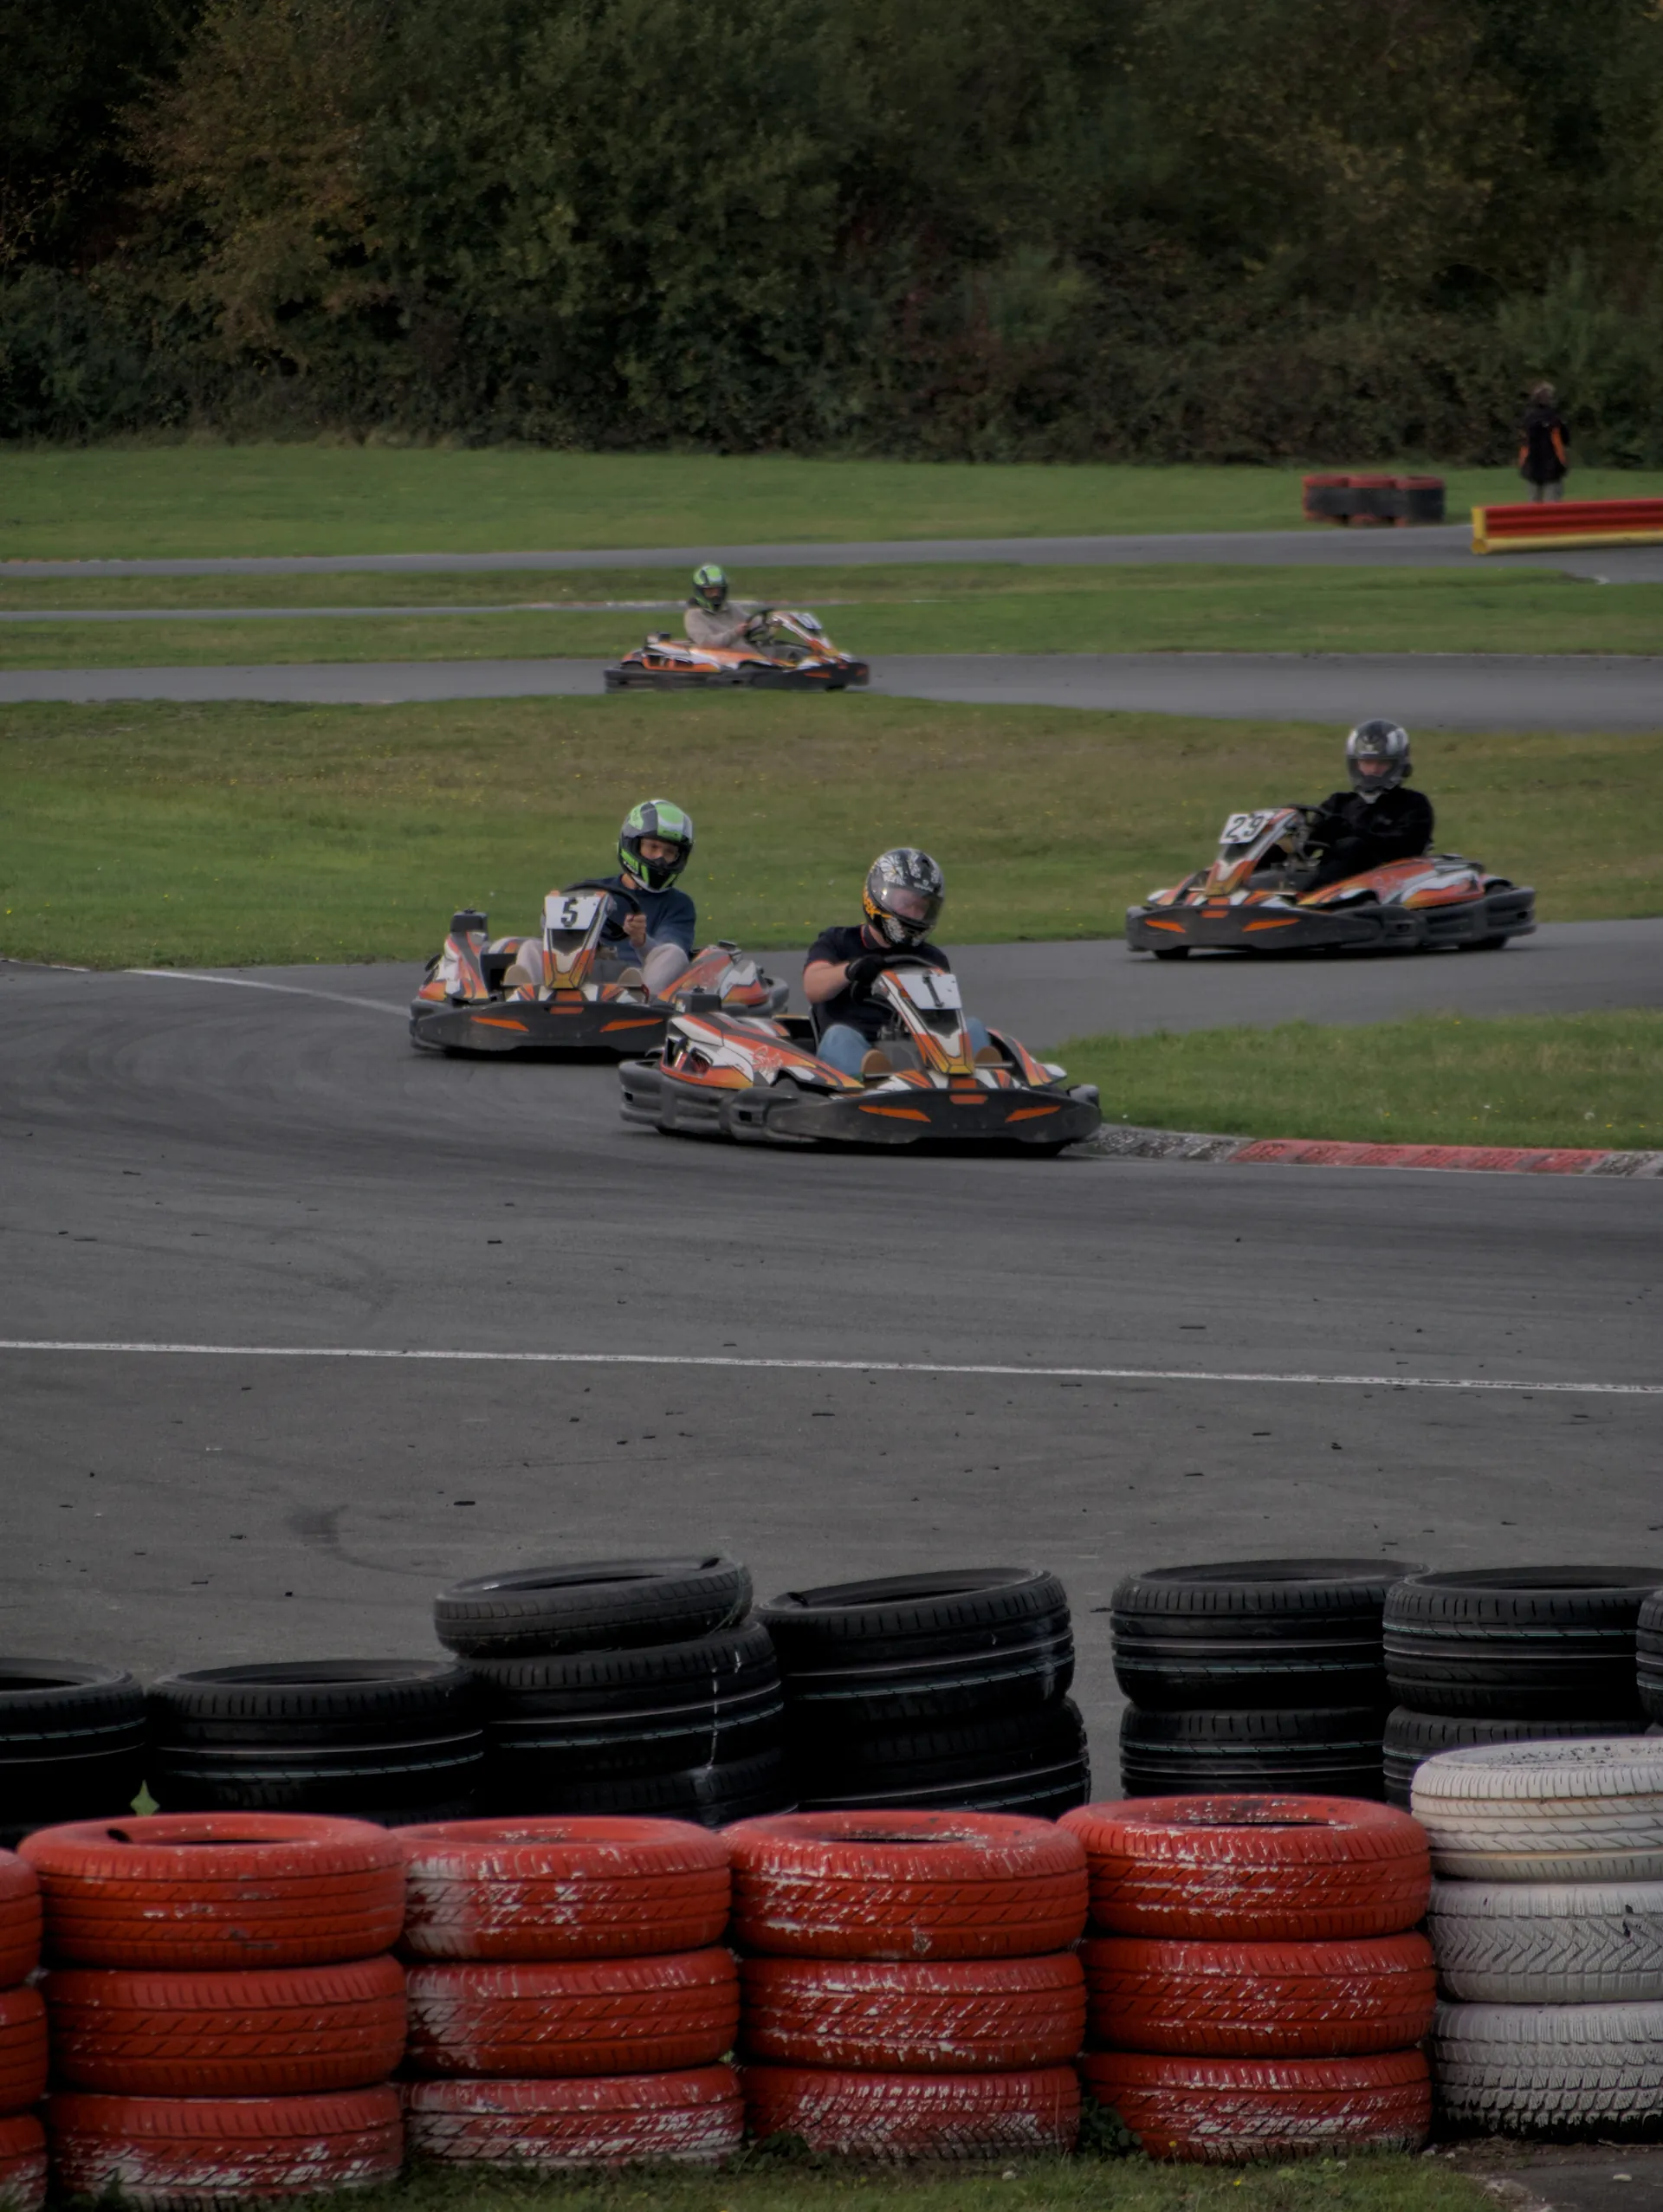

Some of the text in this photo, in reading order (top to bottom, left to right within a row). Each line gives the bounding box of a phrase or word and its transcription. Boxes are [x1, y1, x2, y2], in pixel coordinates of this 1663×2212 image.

[1225, 814, 1265, 838] 29
[560, 896, 579, 928] 5
[922, 971, 944, 1008] 1
